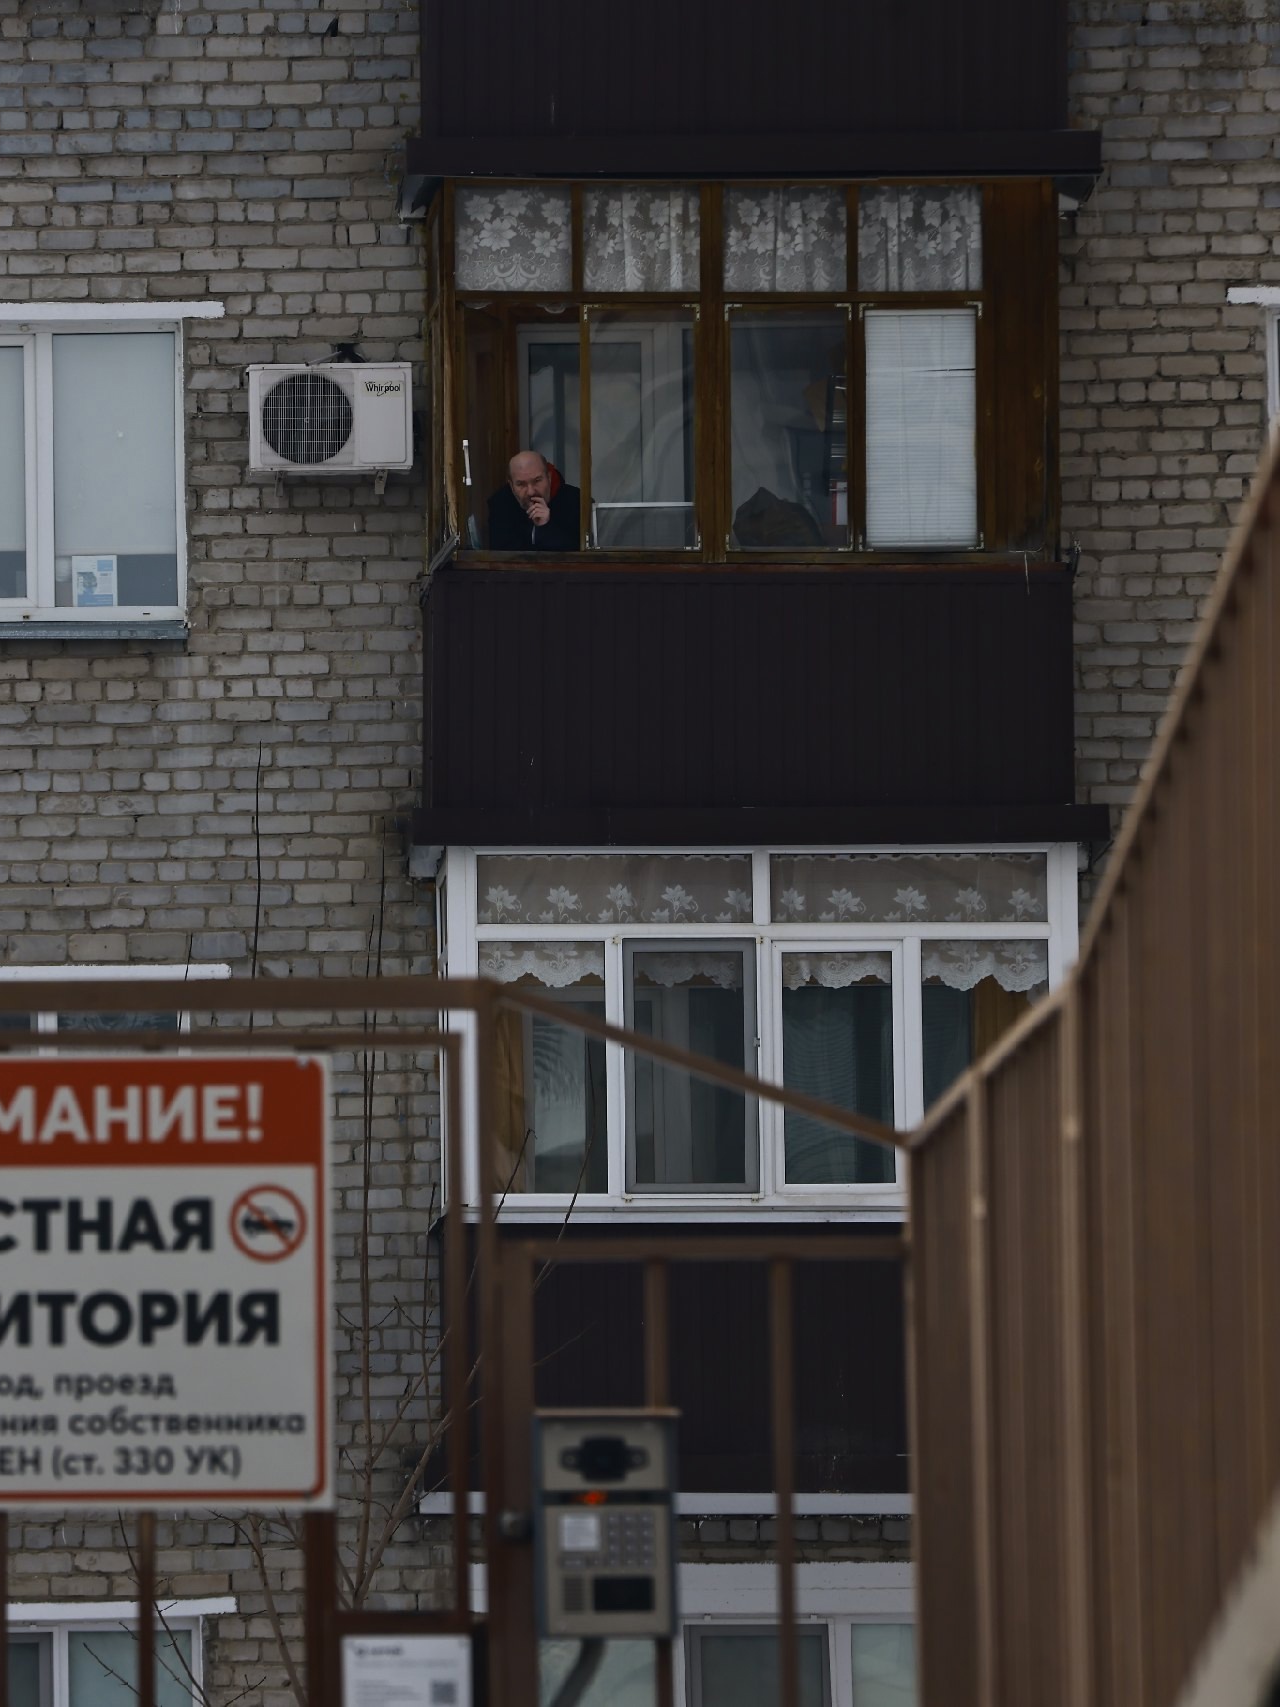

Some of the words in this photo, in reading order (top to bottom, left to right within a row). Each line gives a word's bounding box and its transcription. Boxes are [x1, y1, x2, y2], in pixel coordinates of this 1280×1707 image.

[365, 382, 400, 396] Whirpool
[53, 1373, 177, 1401] проезд
[68, 1405, 306, 1436] собственника
[51, 1446, 104, 1480] (ст.
[113, 1446, 175, 1476] 330
[184, 1445, 242, 1479] УК)
